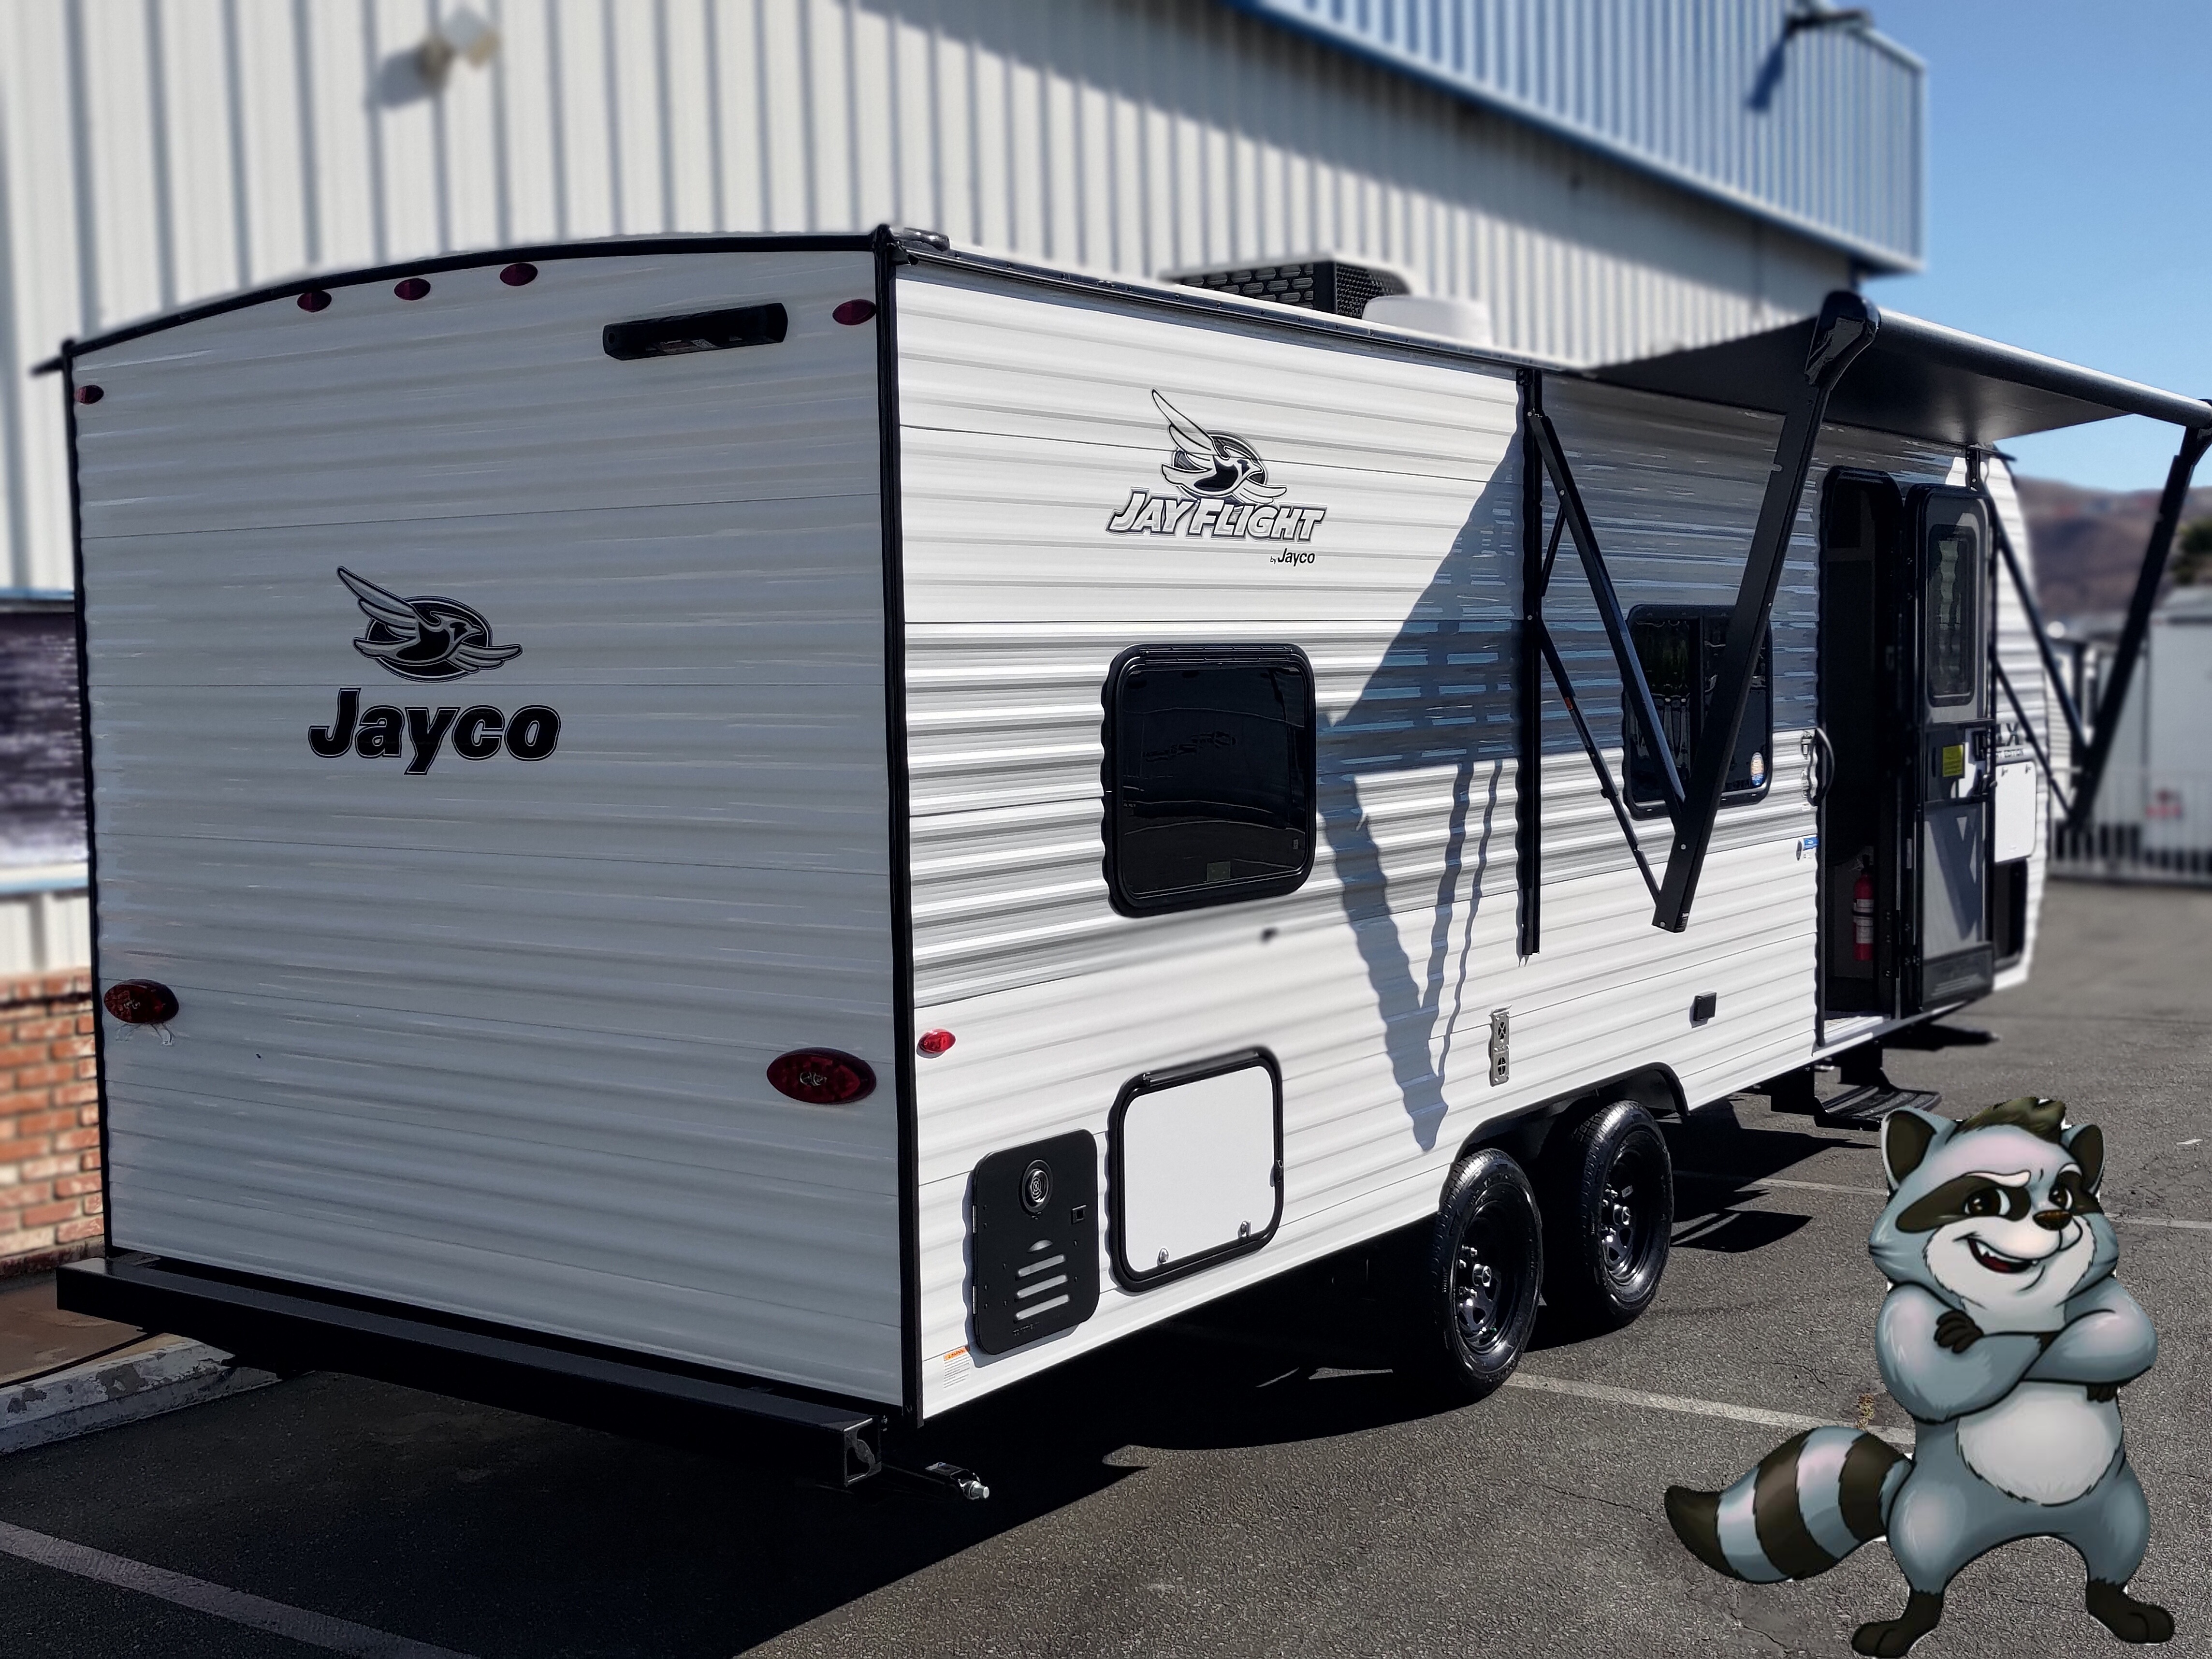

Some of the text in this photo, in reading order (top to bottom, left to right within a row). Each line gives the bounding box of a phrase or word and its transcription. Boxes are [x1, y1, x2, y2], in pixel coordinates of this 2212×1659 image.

[1106, 488, 1327, 543] JAY FLIGHT
[1270, 548, 1316, 567] by Jayco
[308, 687, 561, 775] Jayco
